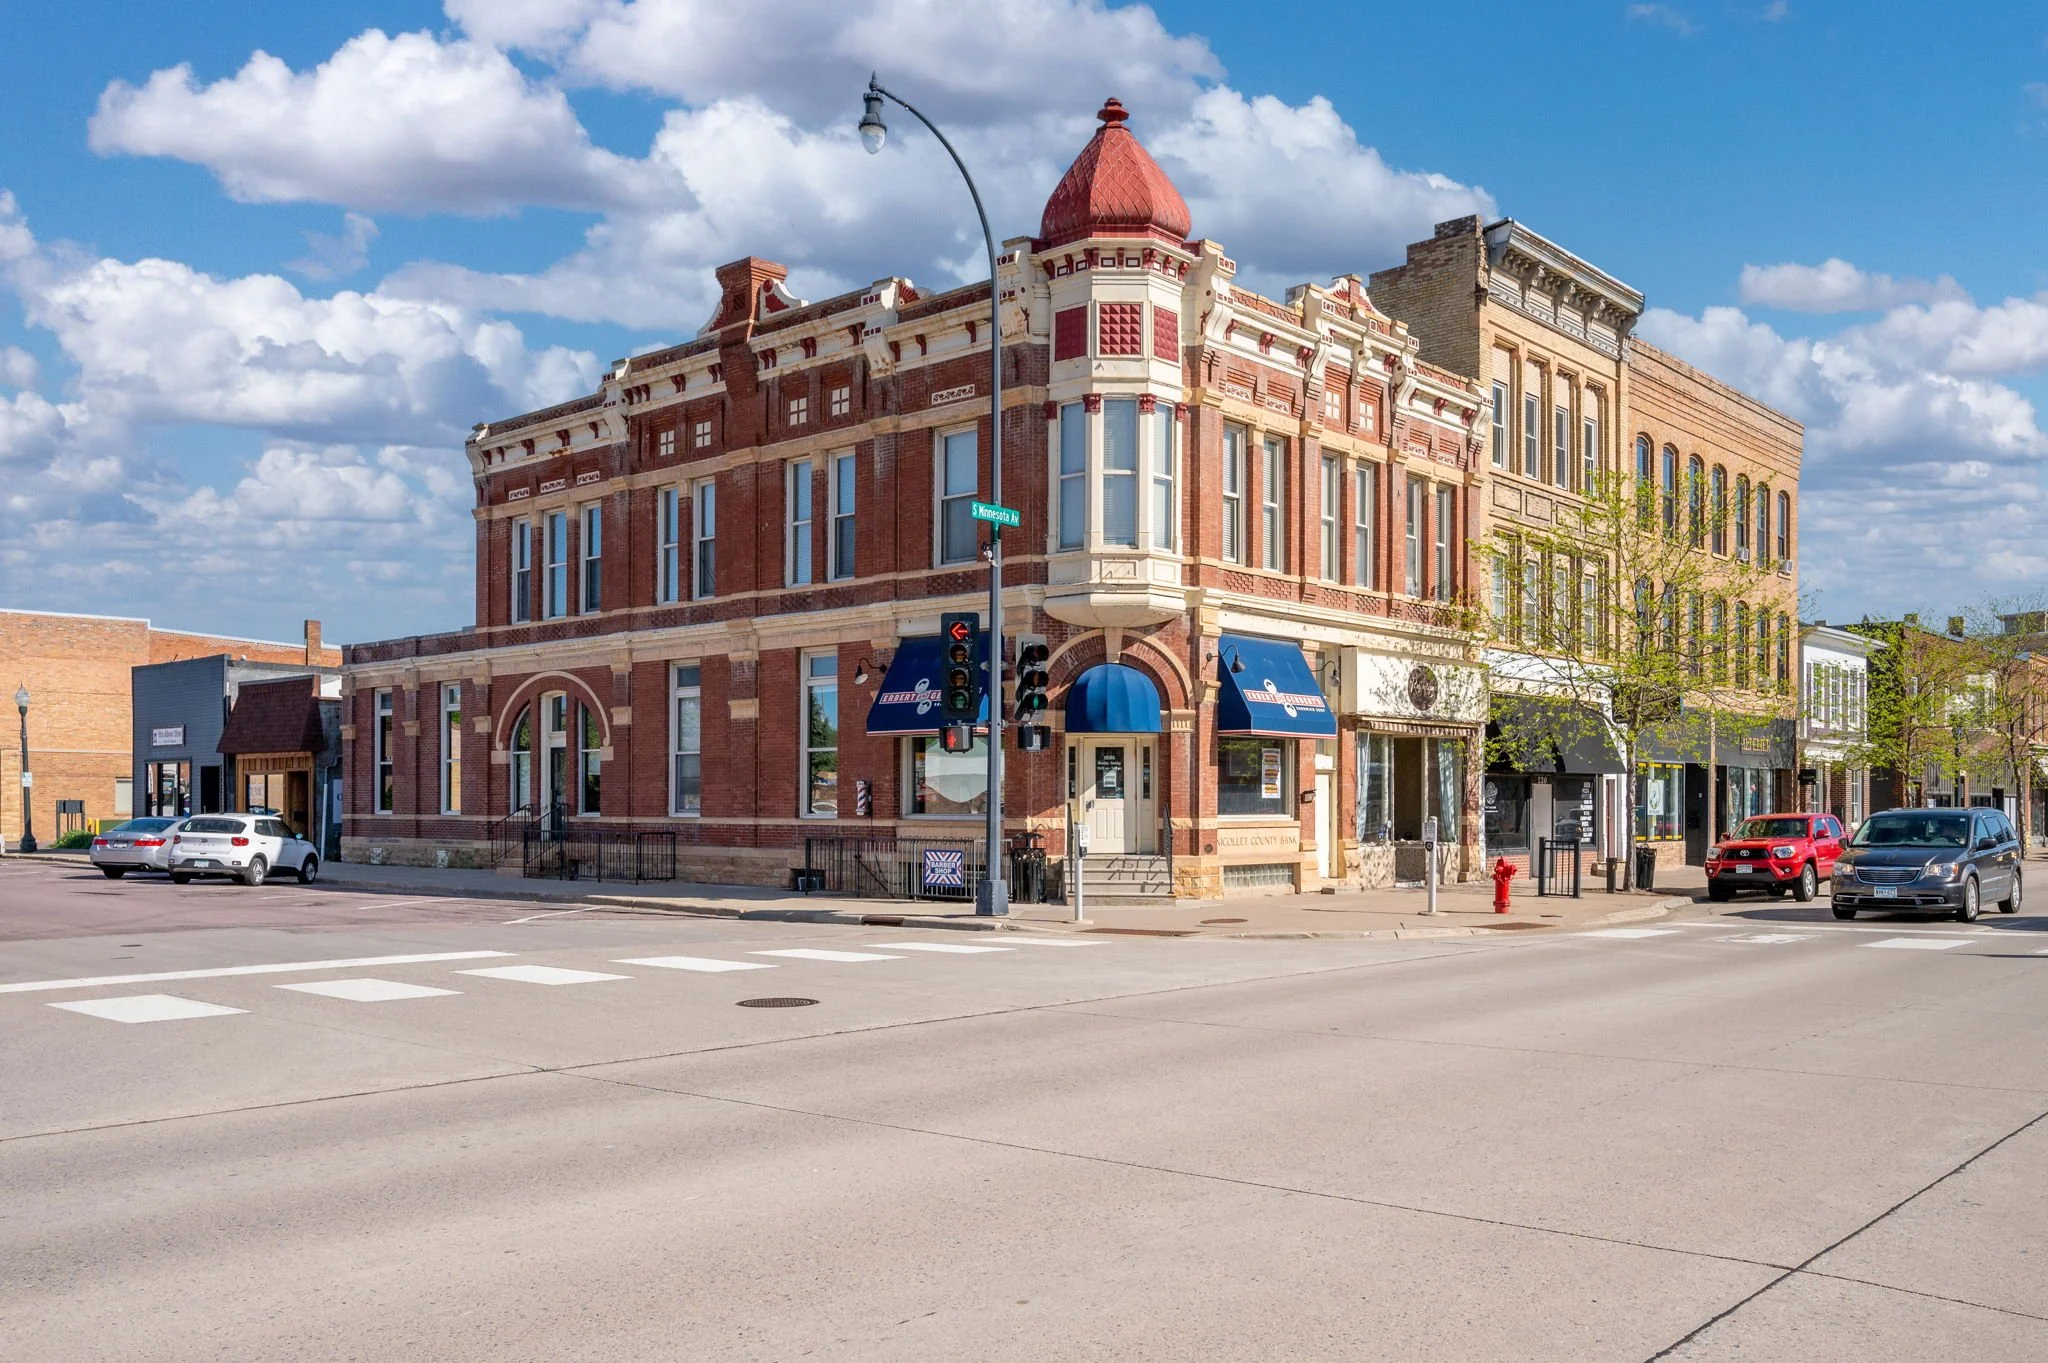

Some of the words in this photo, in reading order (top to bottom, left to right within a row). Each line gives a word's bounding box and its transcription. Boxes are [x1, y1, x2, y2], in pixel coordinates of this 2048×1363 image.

[972, 504, 977, 516] S
[979, 505, 1009, 521] Minnesota
[1011, 512, 1019, 524] Av
[882, 693, 916, 702] ERBERT
[1250, 836, 1278, 846] COUNTY
[1280, 836, 1297, 845] BANK
